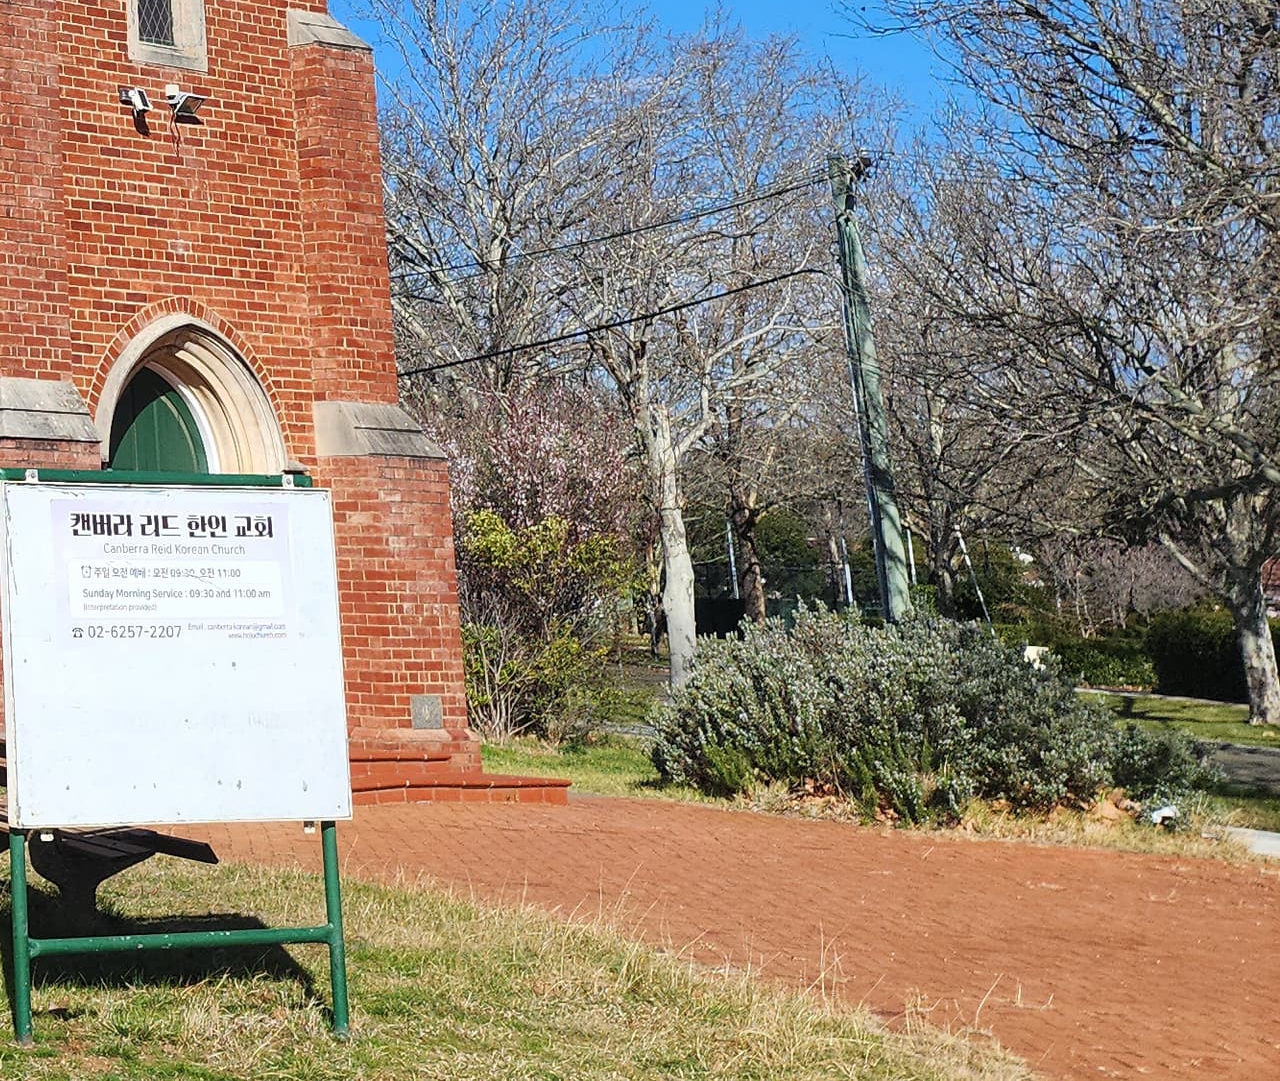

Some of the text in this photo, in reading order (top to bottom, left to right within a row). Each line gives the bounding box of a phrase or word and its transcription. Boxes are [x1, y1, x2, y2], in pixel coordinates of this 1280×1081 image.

[70, 512, 274, 538] 캔버라 리드 한인 교회
[103, 542, 246, 555] Canberra Reid Korean Church
[94, 567, 110, 579] 주일
[112, 567, 128, 579] 오전
[153, 567, 169, 579] 오전
[217, 568, 241, 578] 11:00
[82, 588, 114, 600] Sunday
[115, 589, 151, 601] Morning
[152, 589, 183, 599] Service
[189, 589, 214, 599] 09:30
[215, 589, 231, 599] and
[234, 589, 256, 599] 11:00
[258, 590, 271, 599] am
[87, 625, 182, 639] 02-6257-2207
